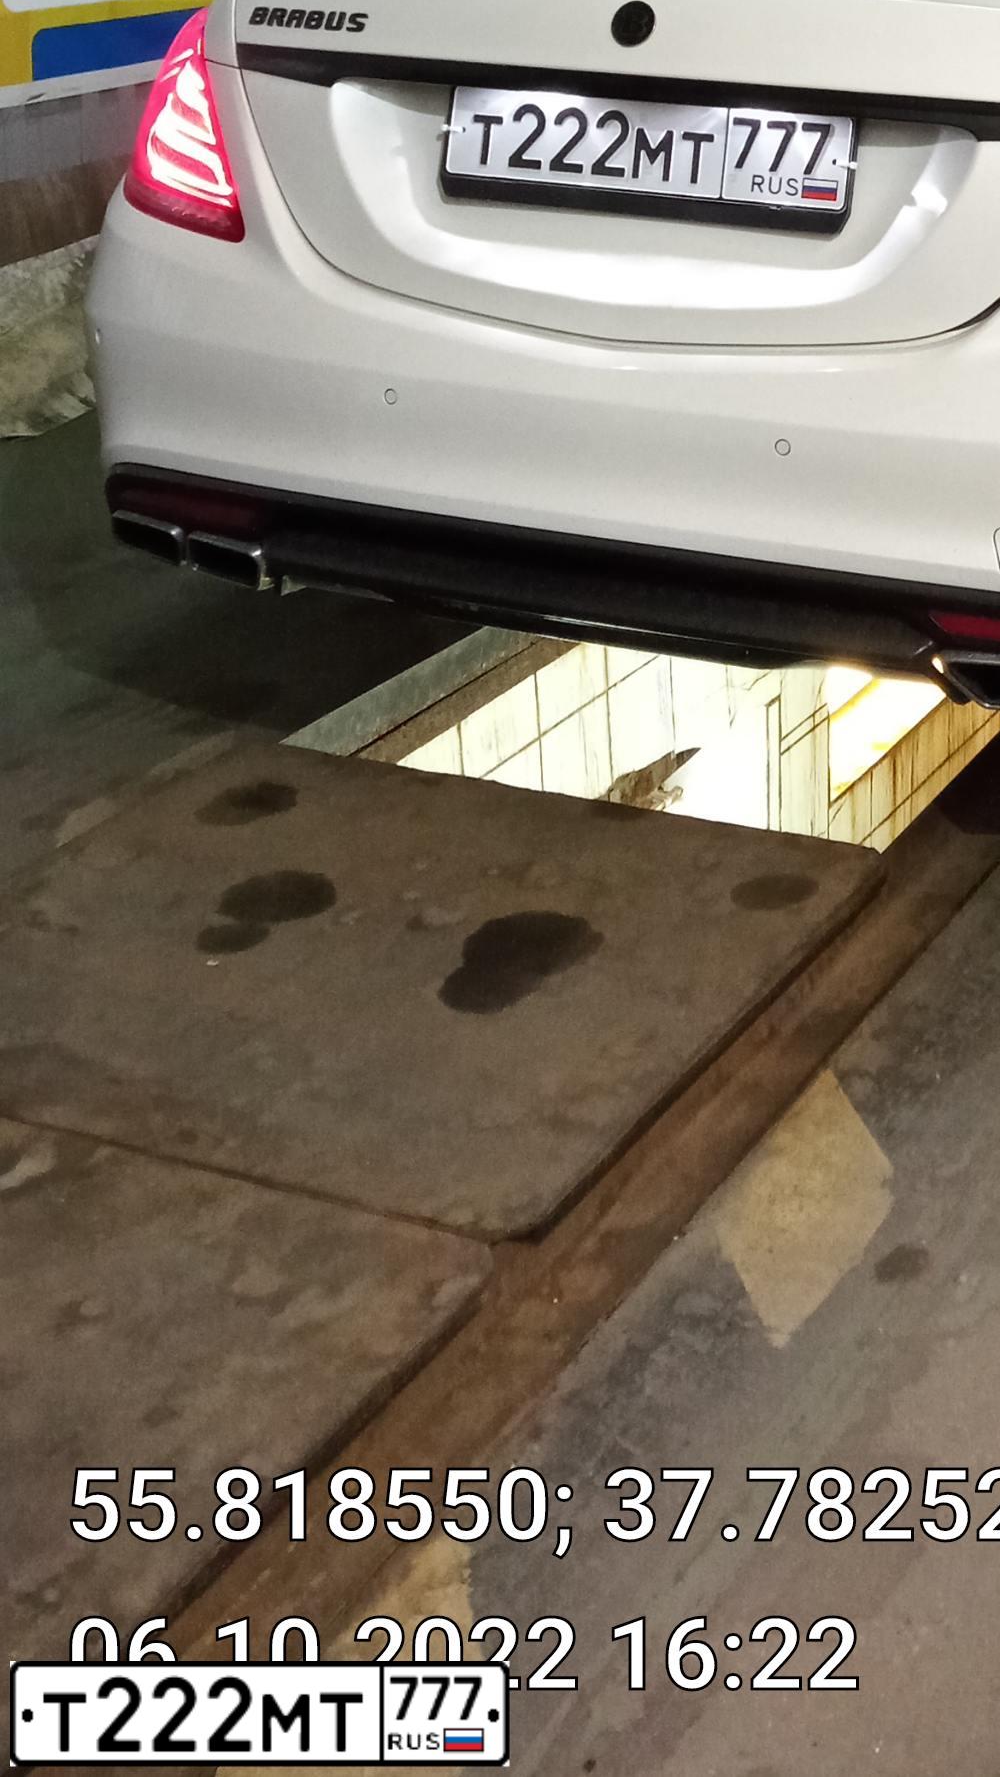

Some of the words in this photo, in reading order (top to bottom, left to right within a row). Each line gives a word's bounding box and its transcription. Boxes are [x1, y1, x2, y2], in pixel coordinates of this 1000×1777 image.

[249, 6, 369, 33] BRABUS
[731, 117, 834, 176] 777
[750, 174, 799, 197] RUS
